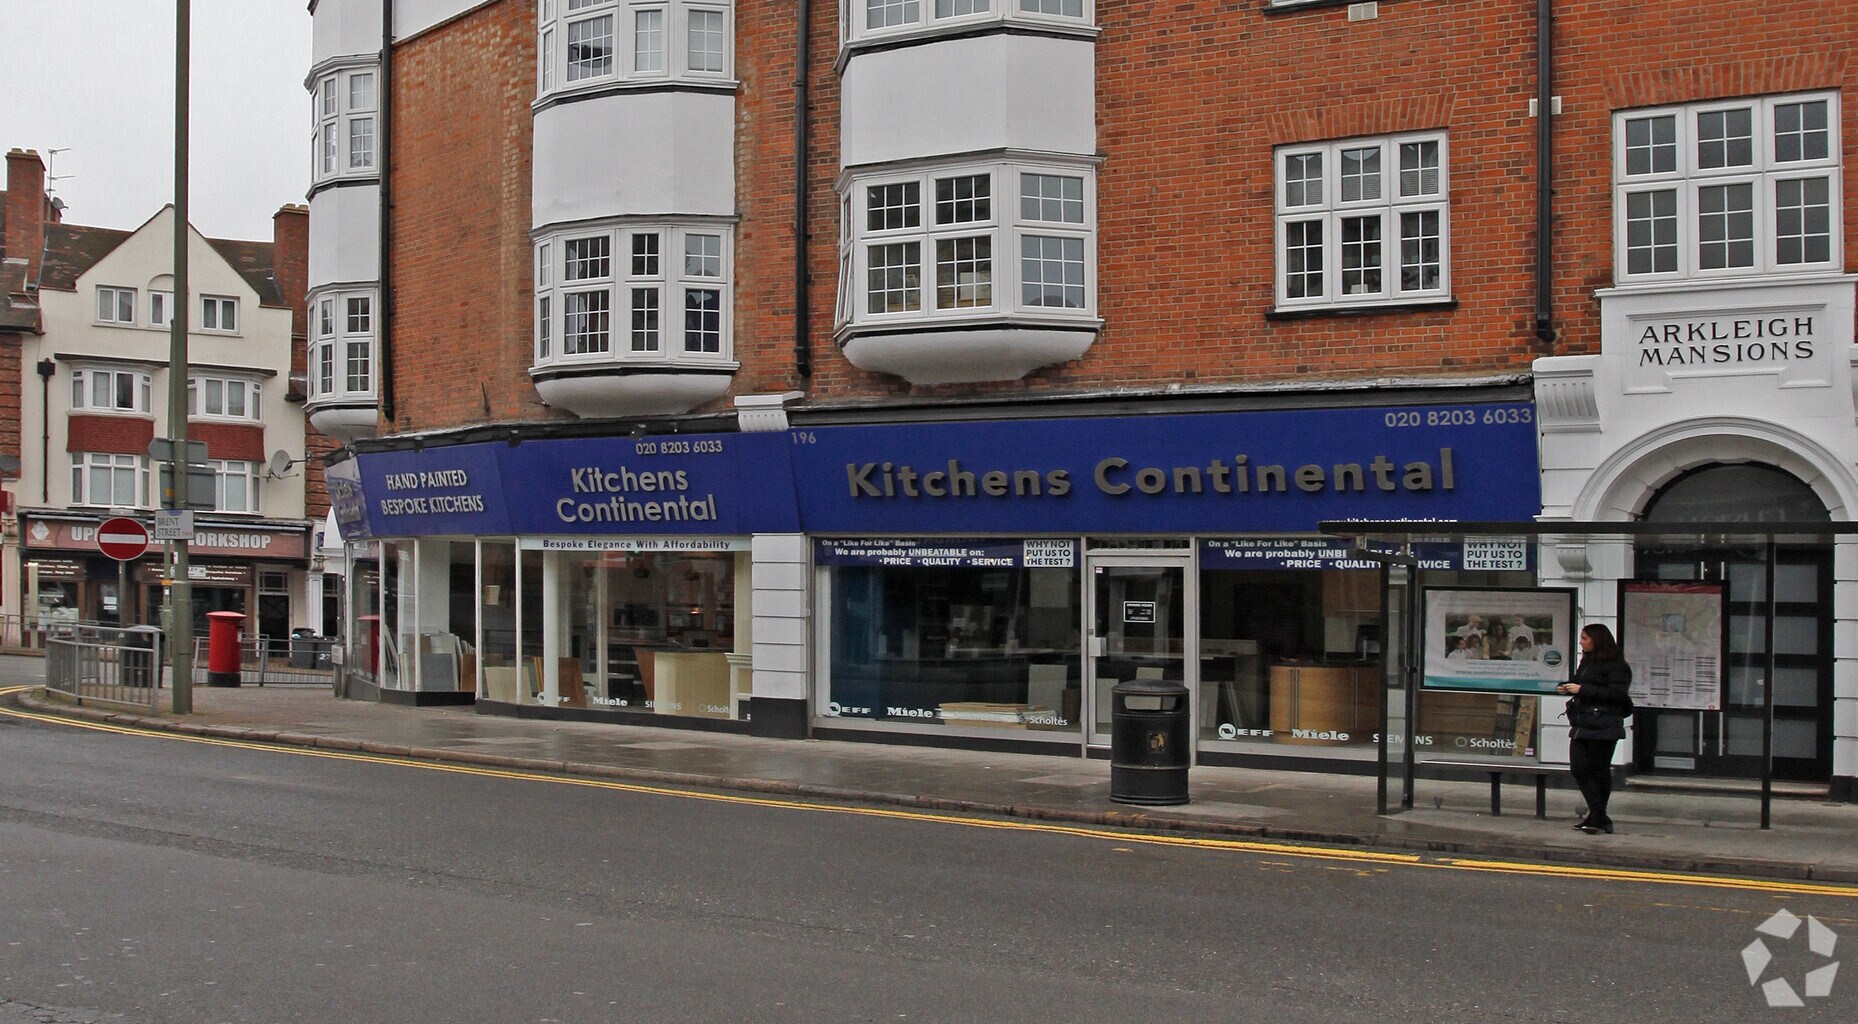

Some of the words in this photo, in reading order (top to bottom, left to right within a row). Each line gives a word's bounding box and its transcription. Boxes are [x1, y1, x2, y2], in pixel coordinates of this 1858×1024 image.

[1638, 317, 1814, 344] ARKLEIGH
[1638, 341, 1814, 366] MANSIONS
[1385, 412, 1421, 427] 020
[1427, 410, 1476, 426] 8203
[1483, 408, 1532, 424] 6033
[791, 431, 816, 445] 196
[636, 443, 657, 455] 020
[661, 441, 690, 454] 8203
[693, 440, 723, 453] 6033
[846, 459, 1072, 497] Kitchens
[1093, 448, 1455, 496] Continental
[385, 473, 418, 490] HAND
[420, 470, 467, 488] PAINTED
[571, 466, 689, 493] Kitchens
[381, 498, 428, 515] BESPOKE
[429, 495, 484, 513] KITCHENS
[556, 494, 718, 523] Continental
[157, 517, 179, 526] BRENT
[157, 528, 181, 537] STREET
[543, 540, 584, 550] Bespoke
[588, 540, 632, 550] Elegance
[636, 540, 659, 549] With
[663, 540, 730, 550] Affordability
[835, 548, 849, 556] We
[867, 548, 907, 557] probably
[908, 548, 967, 557] UNBEATABLE
[1026, 549, 1043, 557] PUT
[1045, 549, 1056, 557] US
[1057, 549, 1070, 557] TO
[1225, 549, 1242, 558] We
[1265, 549, 1315, 559] probably
[1466, 550, 1488, 559] PUT
[1491, 550, 1505, 559] US
[1507, 550, 1523, 559] TO
[884, 557, 911, 565] PRICE
[922, 557, 961, 566] QUALITY
[972, 558, 1013, 566] SERVICE
[1026, 558, 1042, 566] THE
[1043, 558, 1063, 566] TEST
[1286, 559, 1321, 568] PRICE
[1466, 560, 1487, 568] THE
[1489, 560, 1514, 568] TEST
[593, 697, 628, 707] Miele
[886, 707, 933, 718] Miele
[1029, 714, 1068, 726] Scholtès
[1292, 728, 1350, 741] Miele
[1470, 736, 1518, 749] Scholtès
